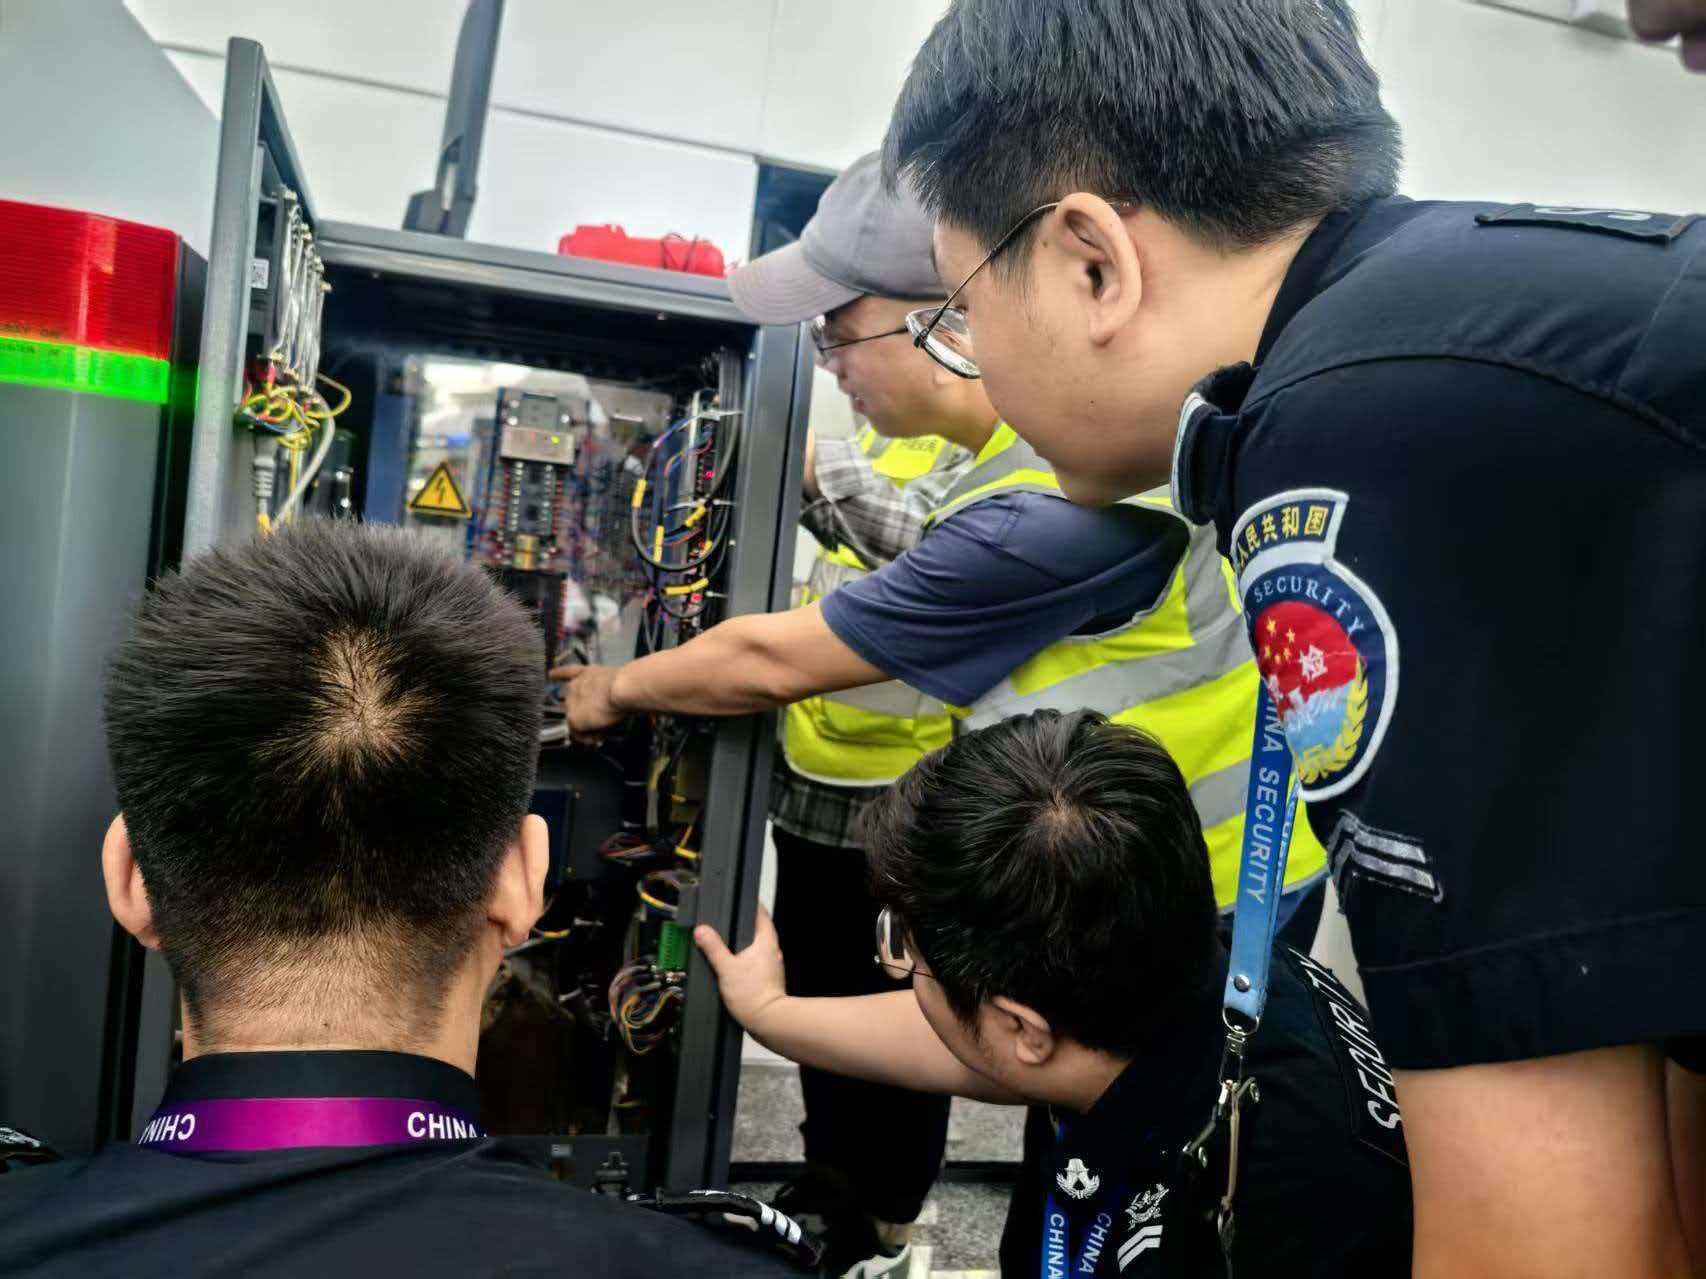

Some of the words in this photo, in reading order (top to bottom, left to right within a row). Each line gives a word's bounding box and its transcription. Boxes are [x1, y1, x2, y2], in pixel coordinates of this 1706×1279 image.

[1254, 575, 1365, 636] SECURITY
[1246, 767, 1280, 904] SECURITY
[1288, 947, 1402, 1129] SECURITY
[138, 1113, 196, 1145] CHIN
[1047, 1213, 1065, 1279] CHINA
[1079, 1212, 1112, 1273] CHINA
